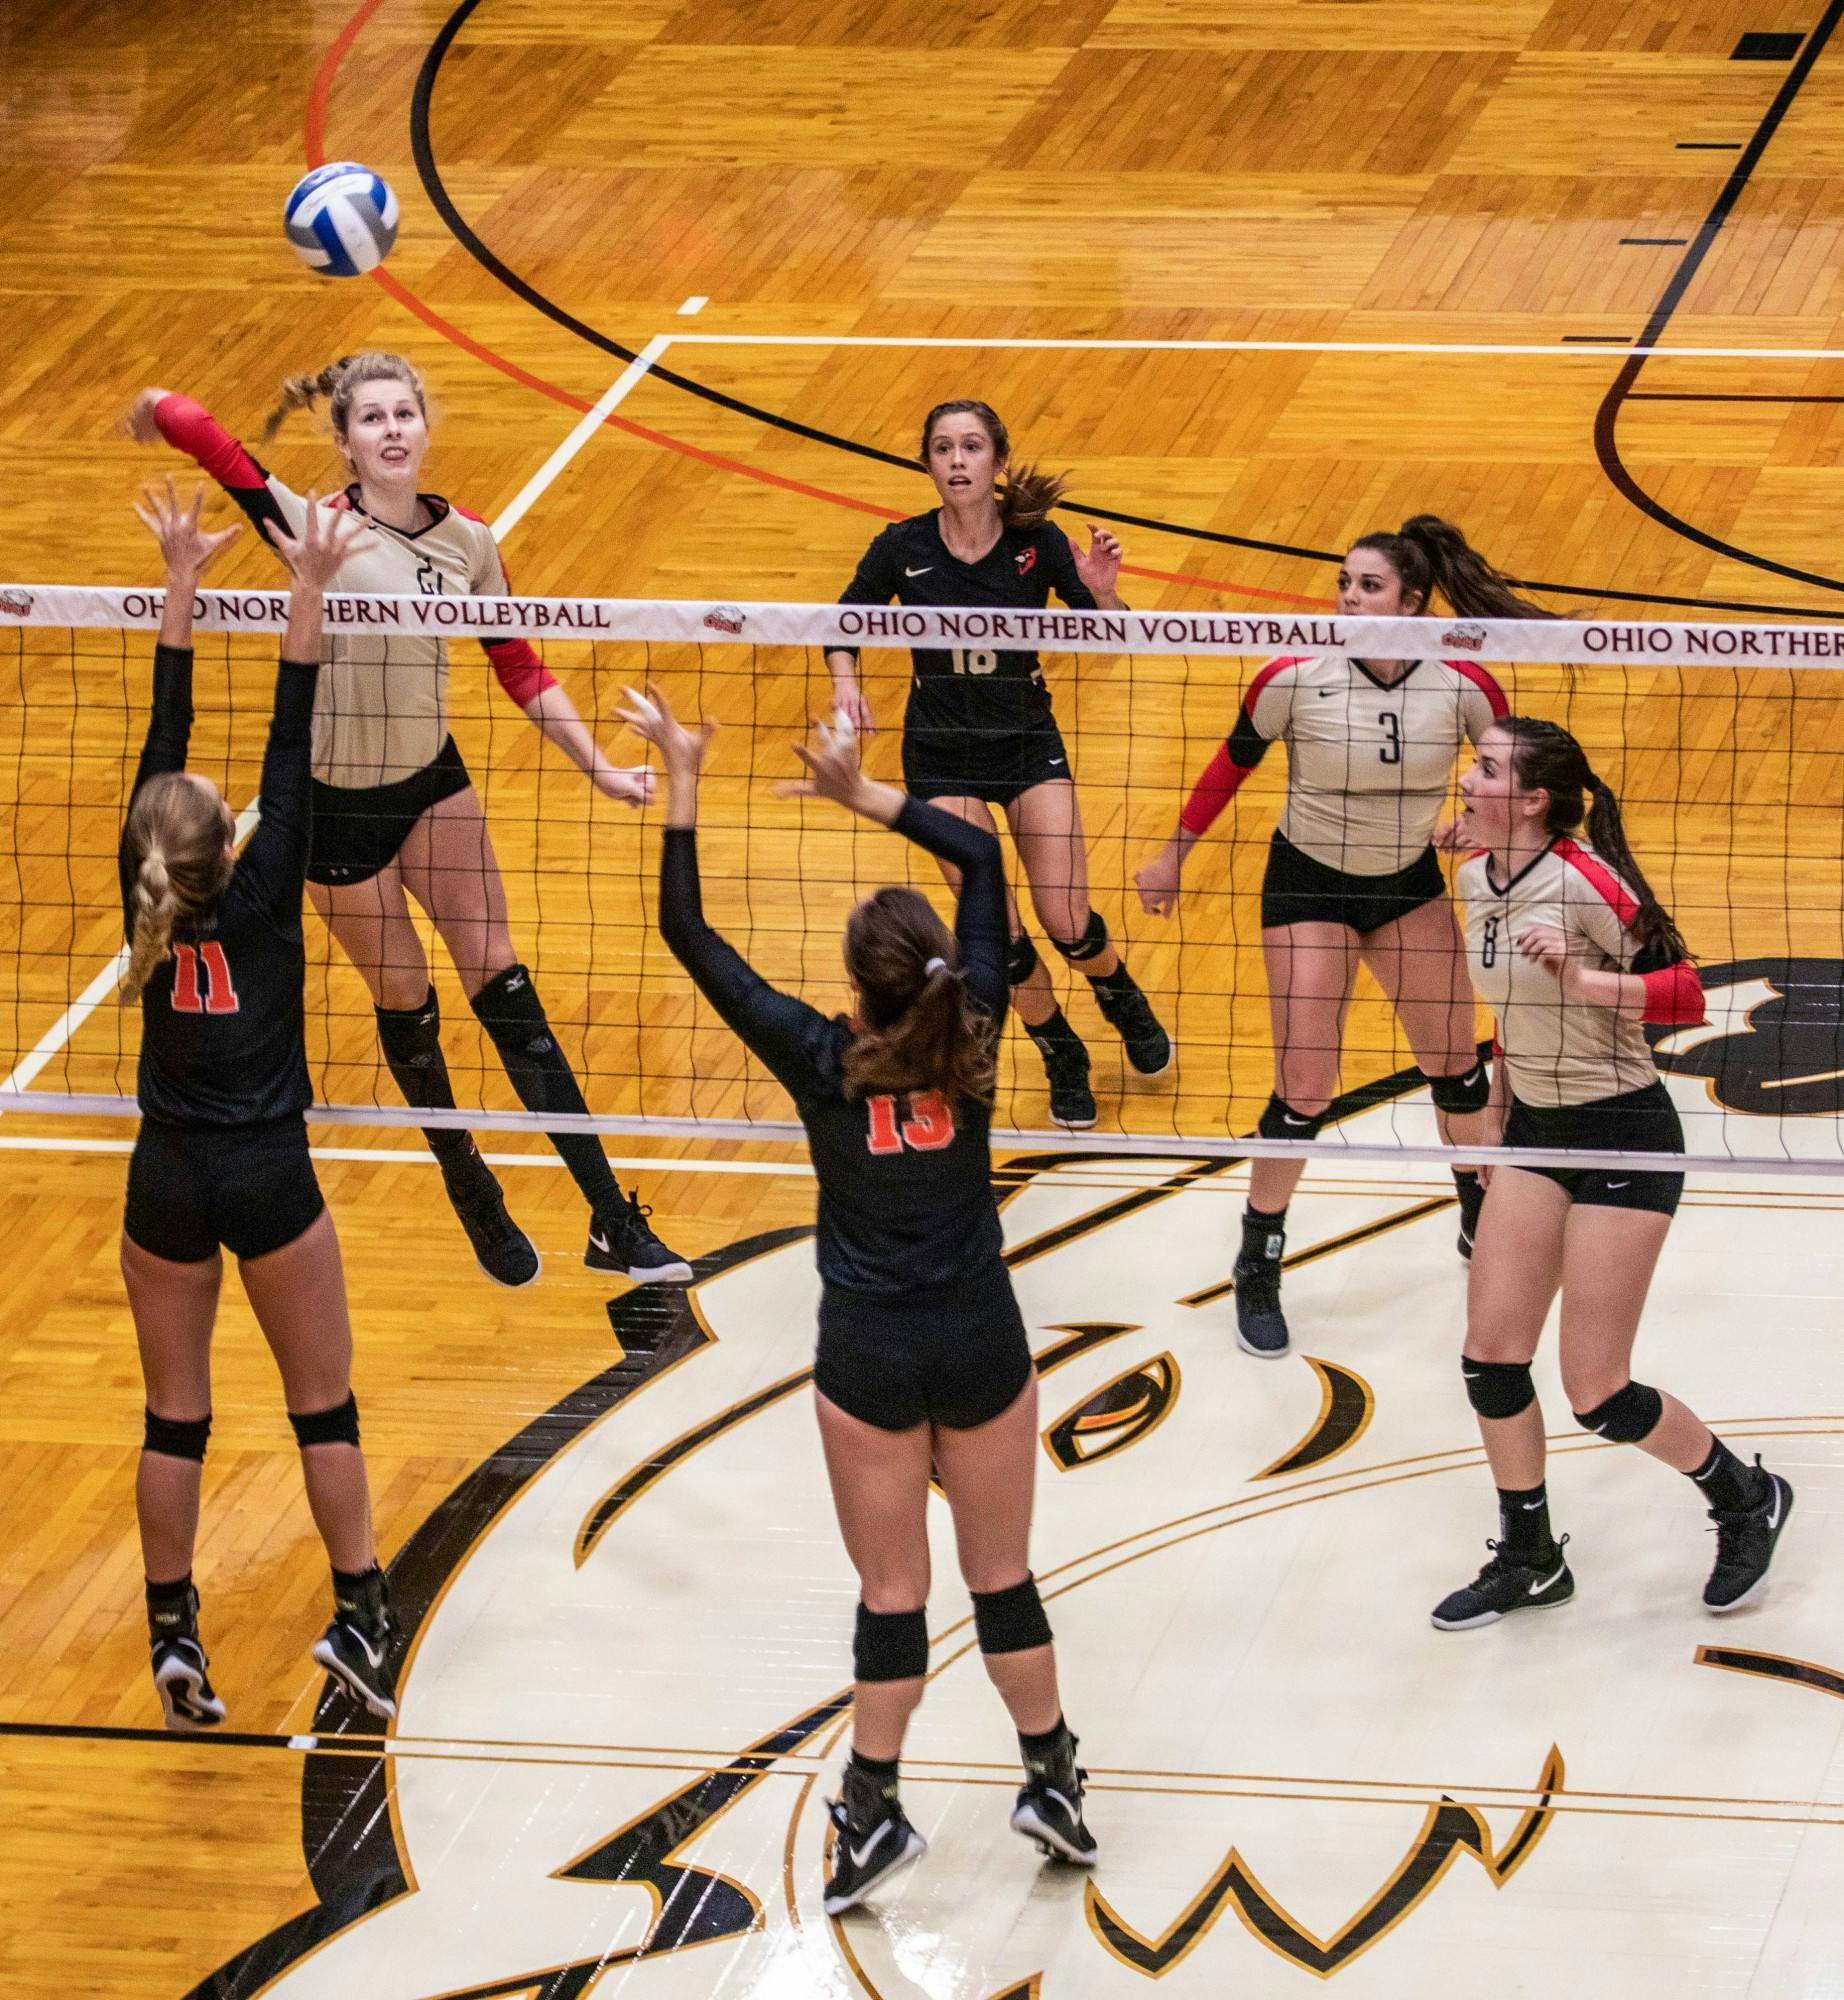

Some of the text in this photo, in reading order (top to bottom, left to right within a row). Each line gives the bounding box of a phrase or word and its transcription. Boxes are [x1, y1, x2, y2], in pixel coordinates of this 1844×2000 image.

[123, 594, 610, 628] OHO NORHERN VOLLEYBALL
[839, 611, 1345, 646] OHIO NORTHERN VOLLEYBALL
[1583, 627, 1673, 652] OHIO
[1378, 712, 1400, 764] 3
[1482, 916, 1499, 968] 8
[171, 941, 239, 1014] 11
